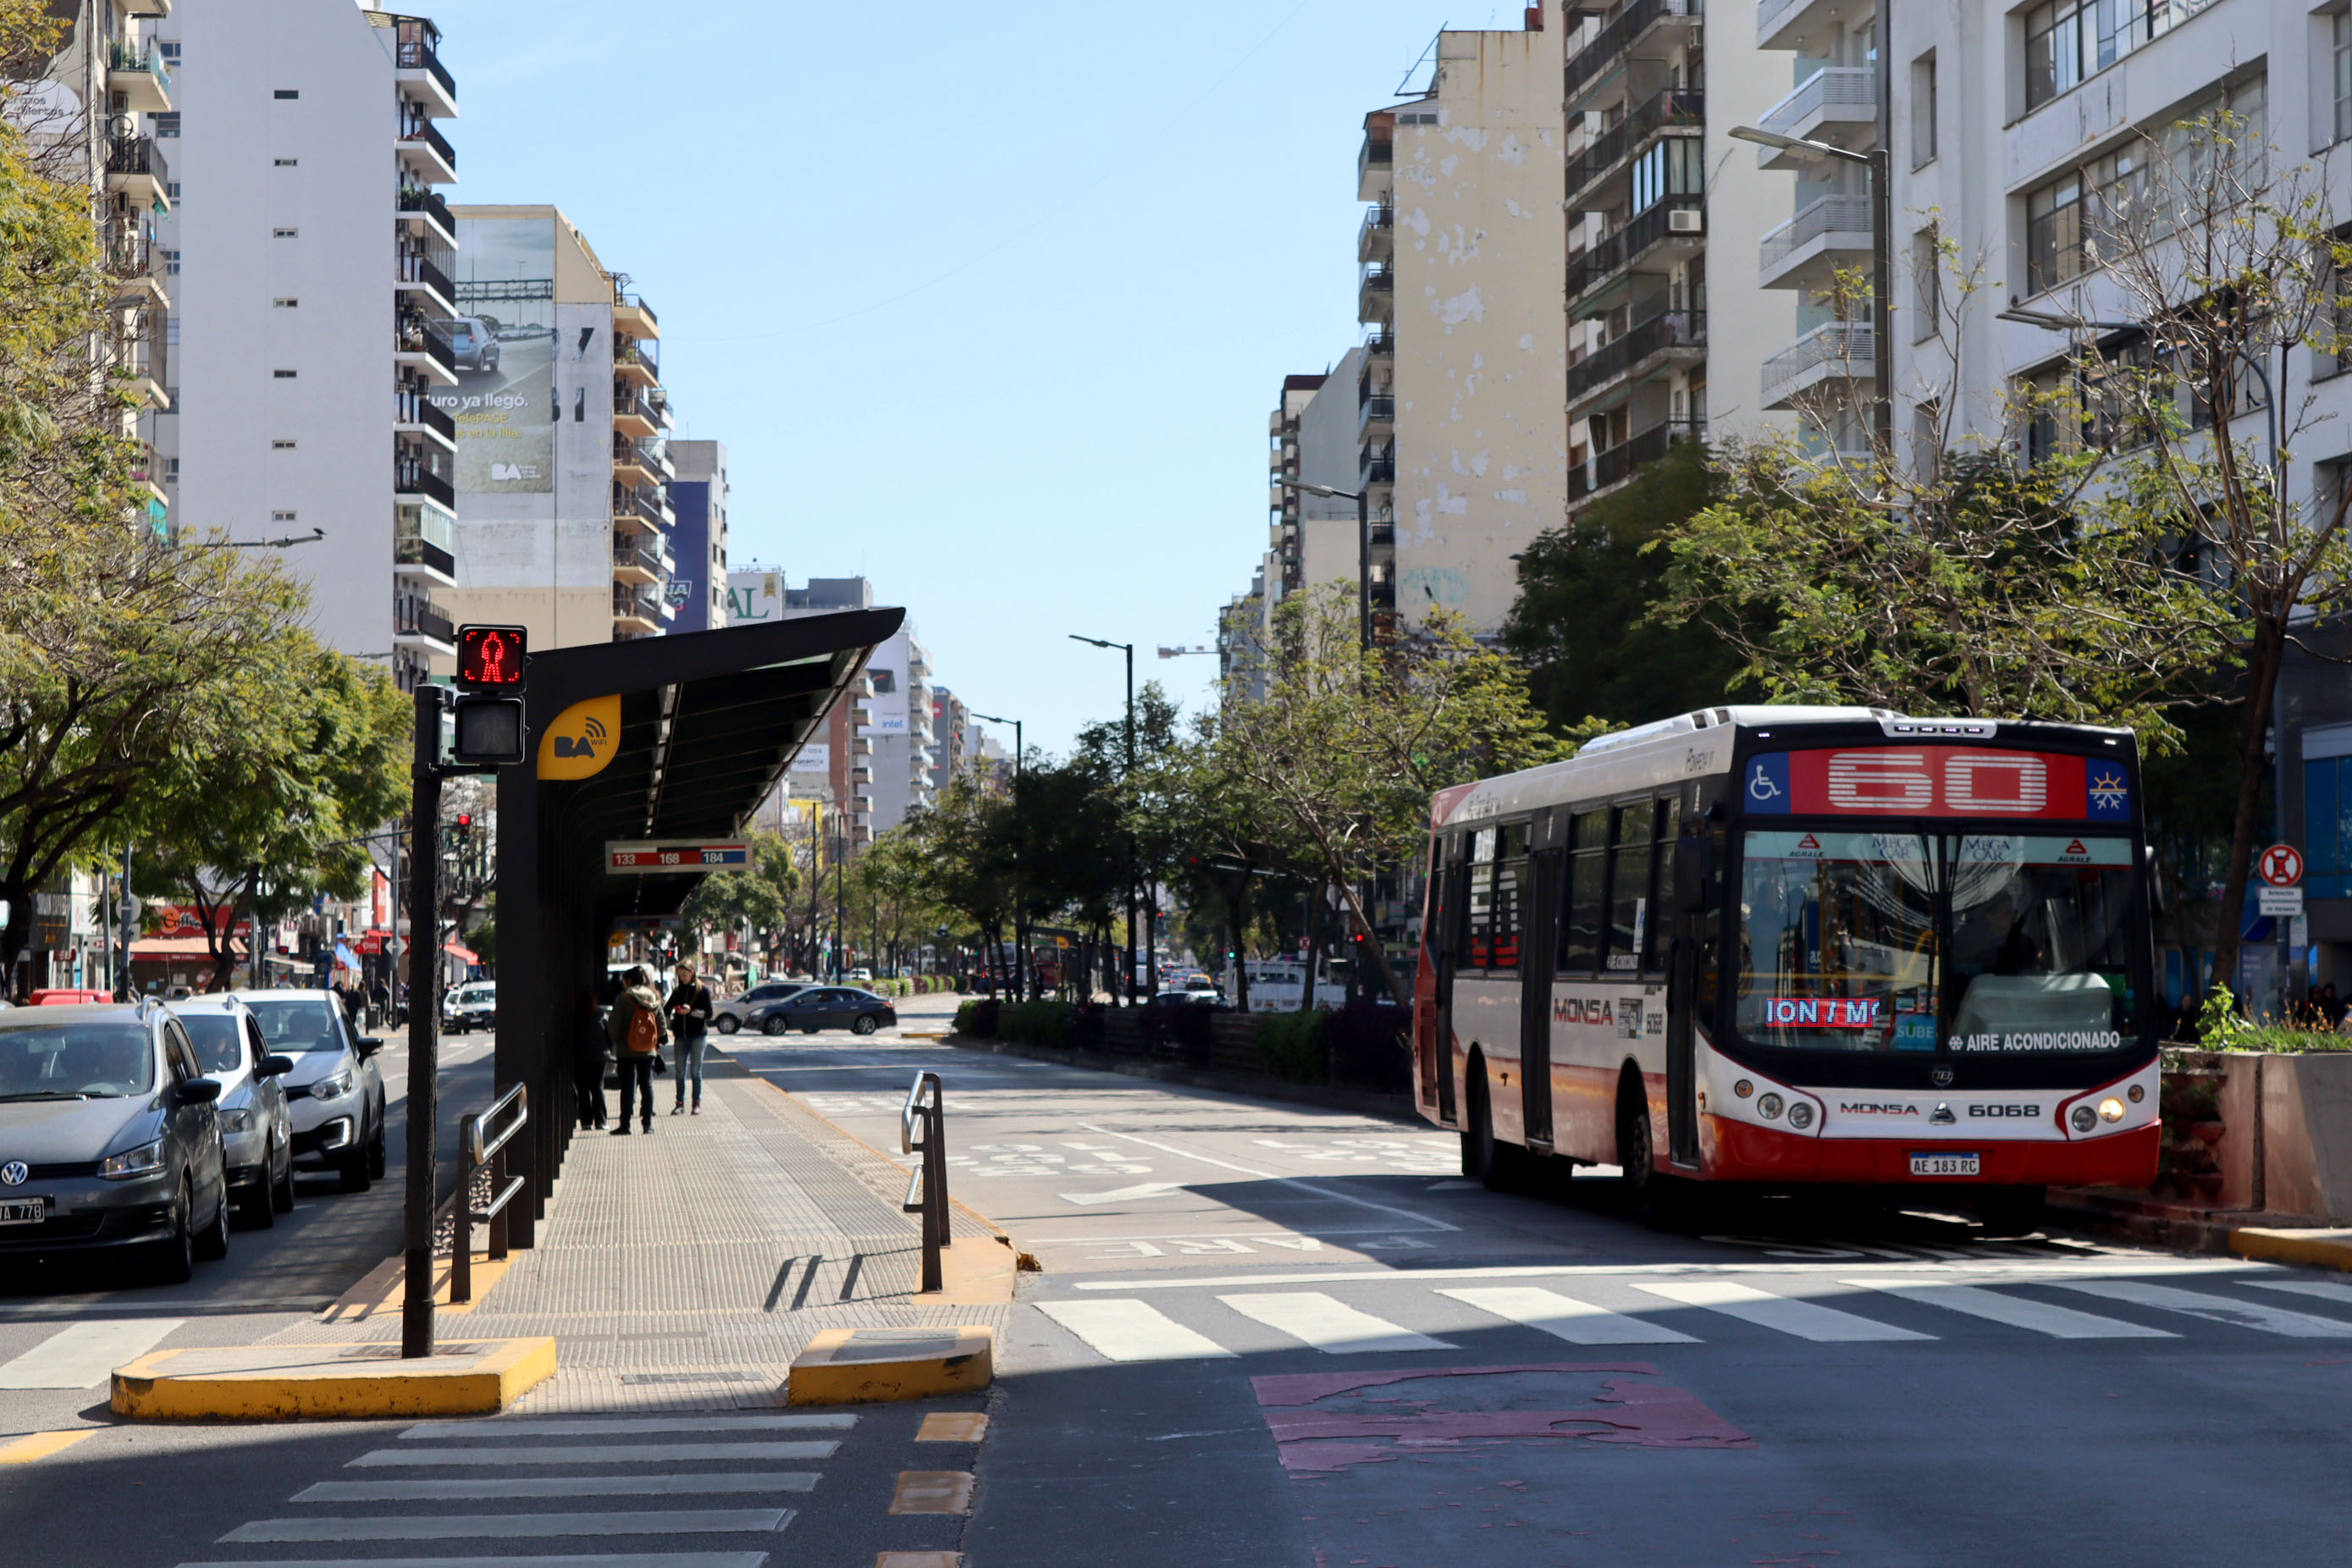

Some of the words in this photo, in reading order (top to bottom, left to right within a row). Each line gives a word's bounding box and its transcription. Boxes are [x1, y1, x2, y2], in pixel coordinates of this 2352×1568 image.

[429, 395, 458, 407] uro
[462, 396, 482, 410] ya
[485, 393, 528, 410] llegó.
[454, 412, 508, 423] TelePASE
[491, 463, 522, 480] BA
[882, 719, 903, 728] intel
[555, 736, 595, 759] BA
[1828, 752, 2047, 812] 60
[1872, 836, 1919, 848] MEGA
[1964, 837, 2011, 851] MEGA
[616, 854, 636, 865] 133
[659, 853, 680, 864] 168
[704, 853, 724, 864] 184
[1879, 847, 1911, 859] CAR
[1973, 848, 2004, 862] CAR
[1554, 998, 1614, 1025] MONSA
[1767, 999, 1818, 1023] ION
[1896, 1023, 1935, 1039] SUBE
[1967, 1034, 2000, 1052] AIRE
[2003, 1030, 2121, 1051] ACONDICIONADO
[1840, 1102, 1920, 1115] MONSA
[1968, 1104, 2040, 1118] 6068
[1913, 1160, 1930, 1173] AE
[1933, 1160, 1957, 1173] 183
[1961, 1159, 1977, 1173] RC
[19, 1205, 42, 1219] 778
[1069, 1236, 1437, 1261] PARE
